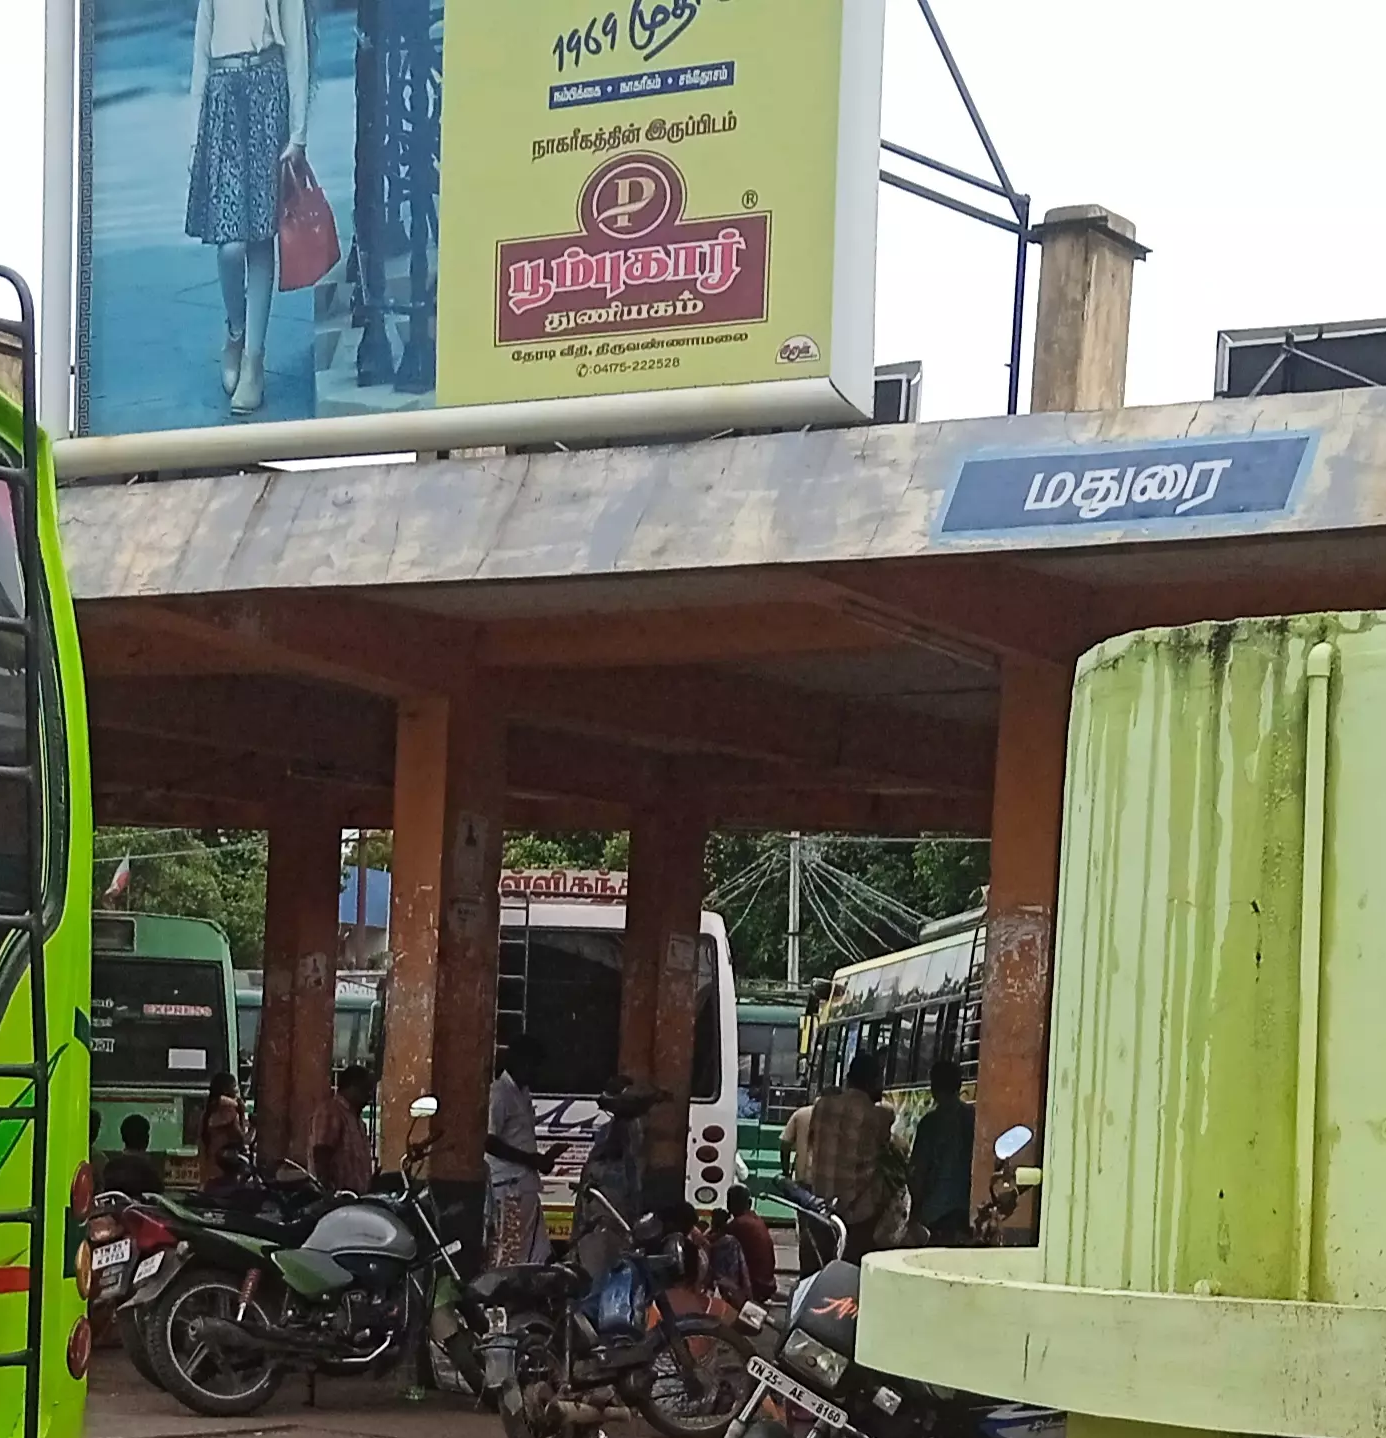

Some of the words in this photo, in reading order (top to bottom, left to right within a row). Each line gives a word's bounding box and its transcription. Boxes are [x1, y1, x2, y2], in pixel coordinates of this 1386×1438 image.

[553, 13, 618, 72] 1969
[629, 0, 732, 61] முத
[532, 122, 642, 161] நாகரீகத்தின்
[645, 110, 737, 144] இருப்பிடம்
[508, 228, 746, 314] பூம்புகார்
[544, 290, 704, 332] துணியகம்
[594, 332, 749, 356] திருவண்ணாமலை
[1023, 458, 1233, 518] மதுரை
[750, 1360, 766, 1377] TN
[788, 1387, 806, 1402] AE
